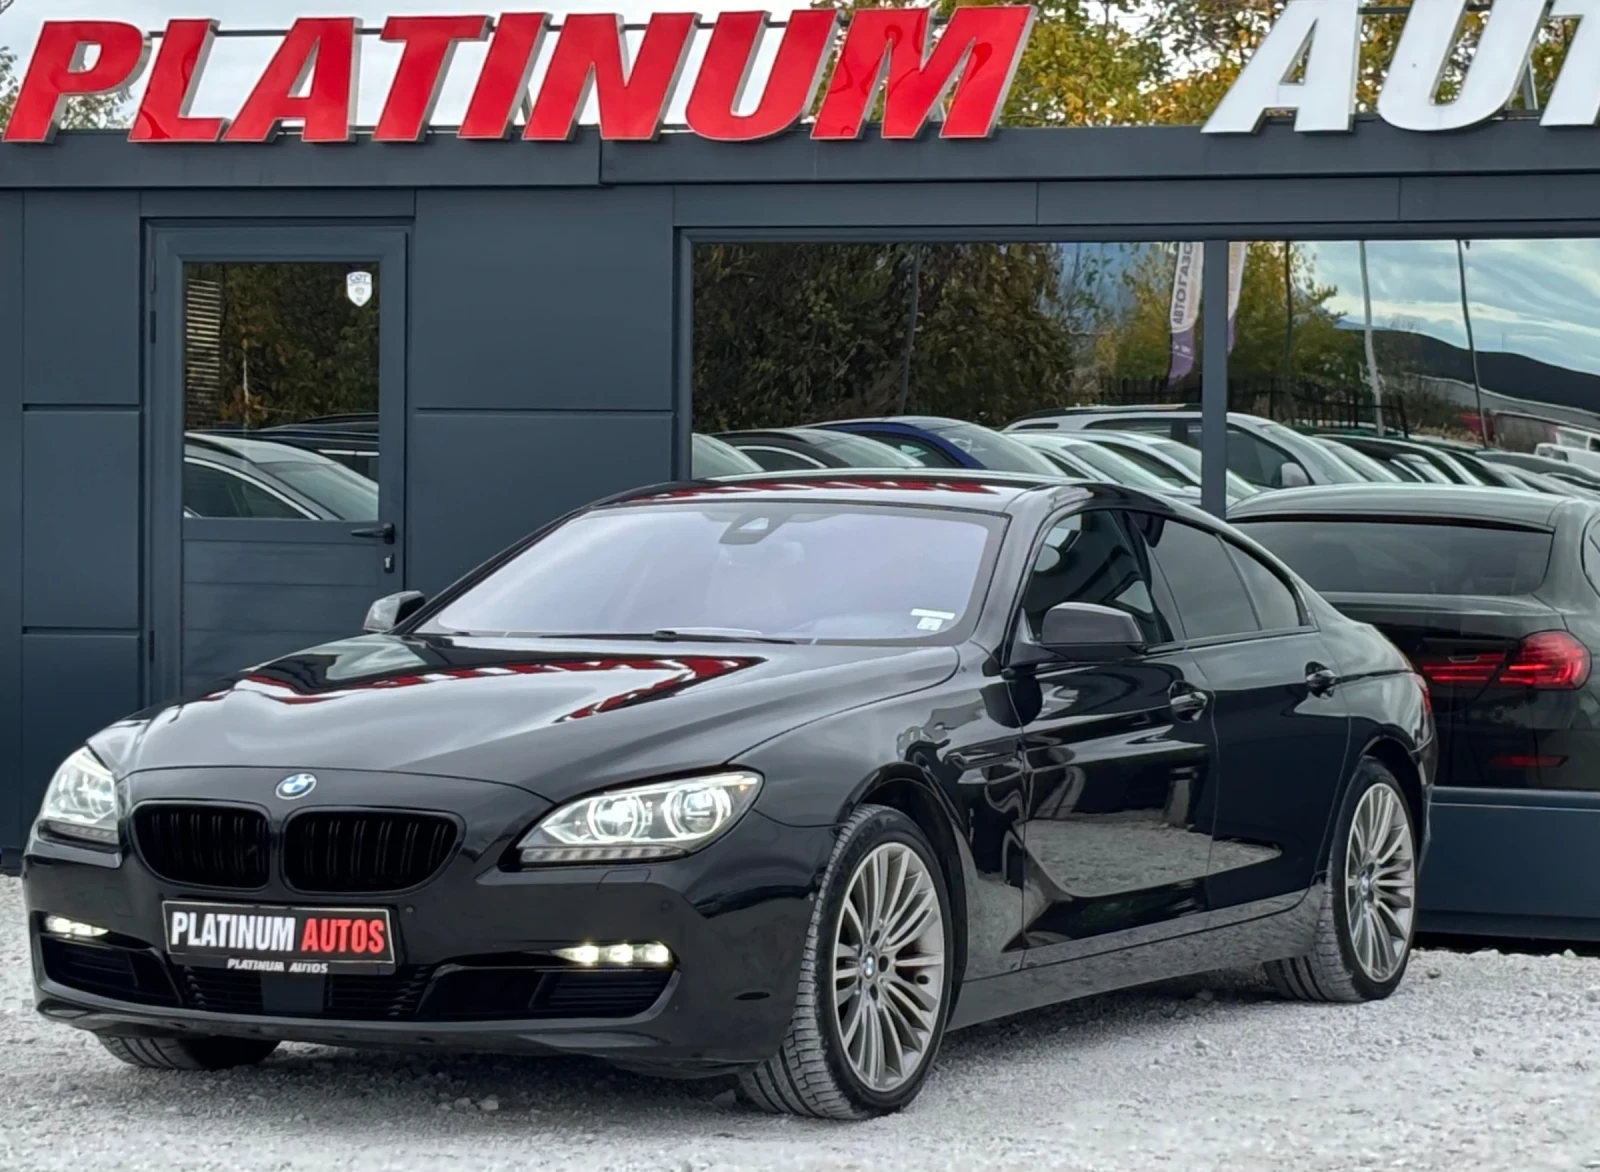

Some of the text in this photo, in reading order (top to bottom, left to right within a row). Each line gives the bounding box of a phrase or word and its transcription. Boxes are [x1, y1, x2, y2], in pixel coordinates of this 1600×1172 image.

[2, 5, 1036, 143] PLATINUM
[171, 911, 385, 954] PLATINUM AUTOS
[227, 958, 328, 974] PLATINUM AUTOS
